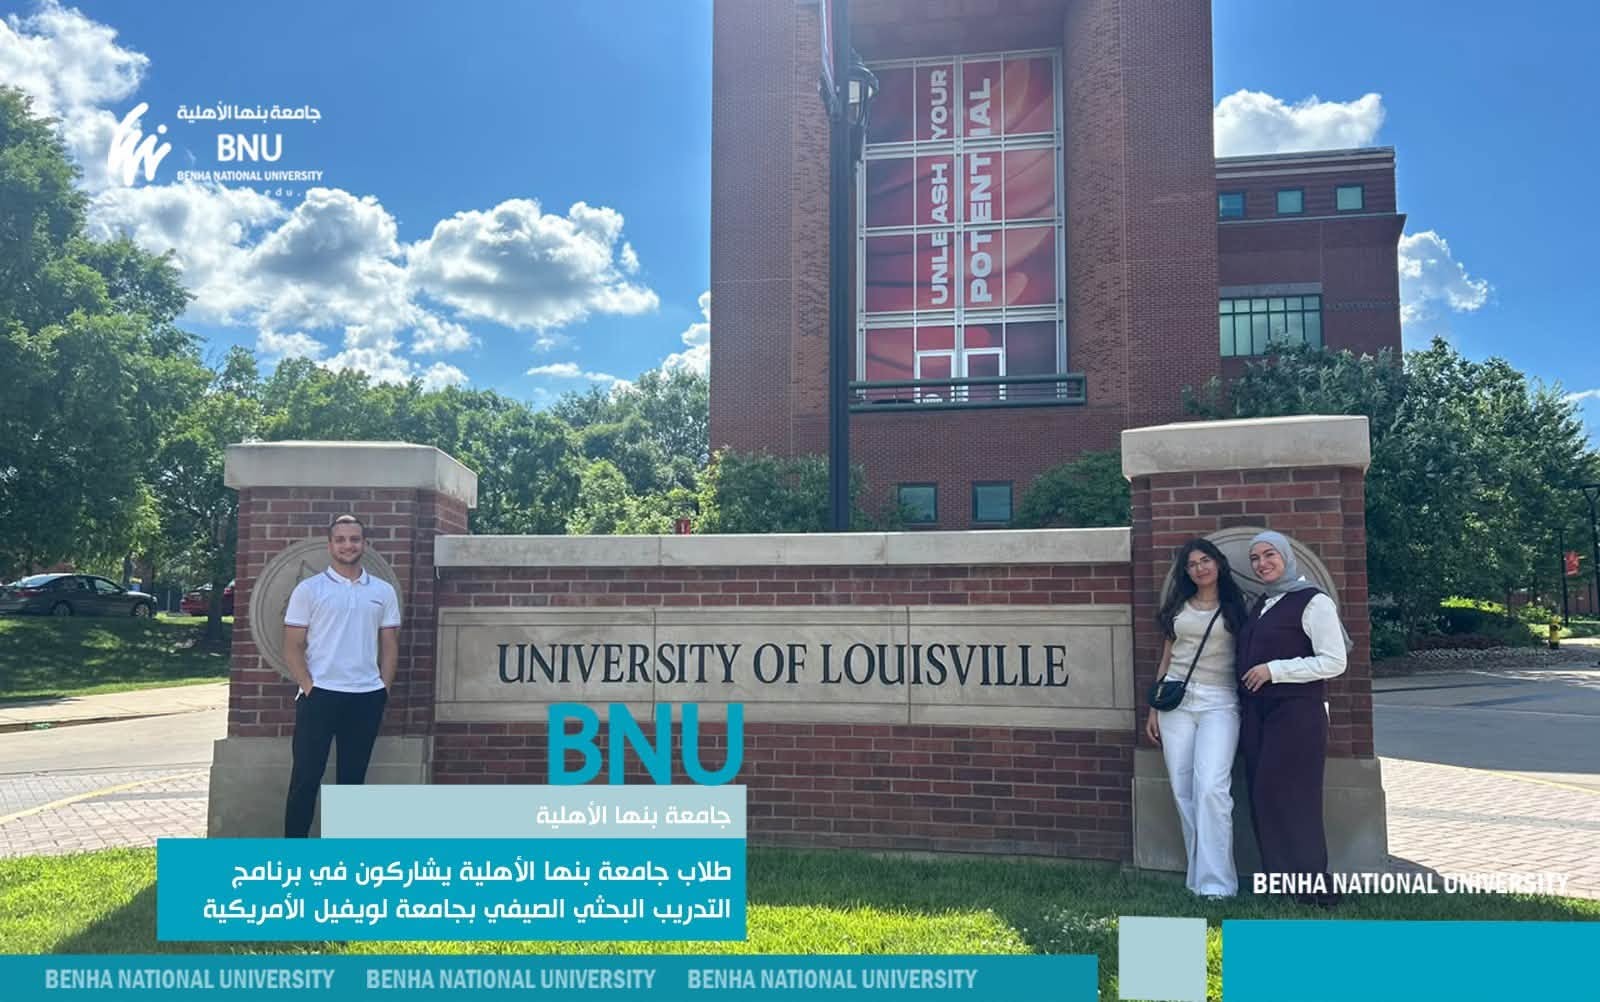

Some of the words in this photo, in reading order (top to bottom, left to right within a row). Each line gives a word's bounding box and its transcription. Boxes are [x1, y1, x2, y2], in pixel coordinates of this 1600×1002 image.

[931, 70, 948, 142] YOUR
[931, 163, 948, 305] UNLEASH
[969, 78, 992, 303] POTENTIAL
[497, 643, 742, 685] UNIVERSITY
[753, 643, 806, 686] OF
[821, 643, 1069, 689] LOUISVILLE
